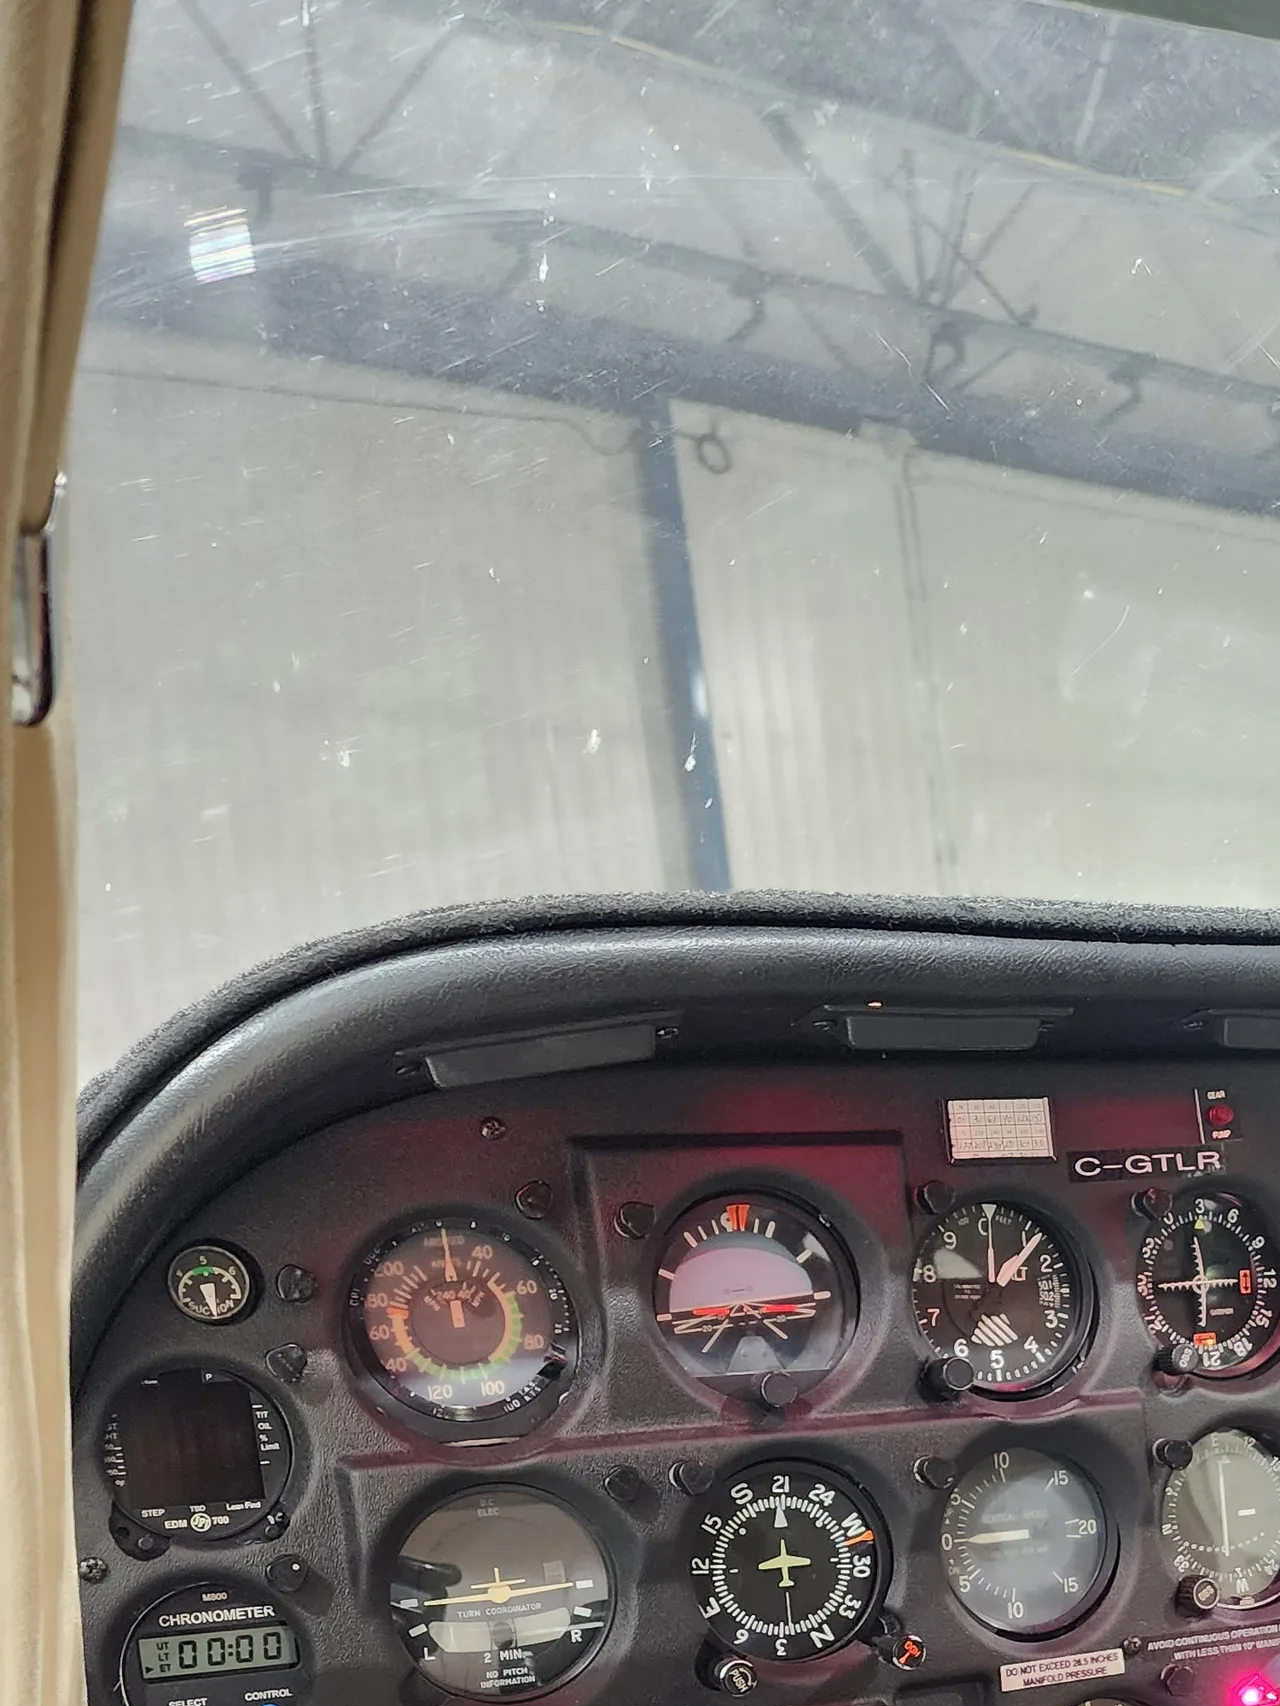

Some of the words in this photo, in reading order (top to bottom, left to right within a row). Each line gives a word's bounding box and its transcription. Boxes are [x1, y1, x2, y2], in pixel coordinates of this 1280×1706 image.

[1074, 1150, 1222, 1177] C-GTLR
[1195, 1198, 1205, 1214] 3
[1226, 1208, 1239, 1223] 6
[943, 1231, 957, 1249] 9
[1251, 1236, 1265, 1250] 9
[200, 1255, 208, 1266] 5
[471, 1244, 494, 1260] 40
[1040, 1254, 1053, 1273] 2
[923, 1264, 937, 1283] 8
[1262, 1270, 1278, 1288] 12
[516, 1279, 537, 1295] 60
[189, 1299, 236, 1317] SUCION
[926, 1308, 940, 1327] 7
[1044, 1309, 1058, 1328] 3
[1255, 1308, 1274, 1329] 15
[523, 1334, 545, 1350] 80
[953, 1338, 968, 1357] 6
[1023, 1335, 1040, 1353] 4
[990, 1350, 1005, 1369] 5
[427, 1384, 454, 1400] 120
[480, 1380, 505, 1397] 100
[993, 1451, 1010, 1470] 10
[771, 1475, 790, 1493] 21
[1054, 1470, 1069, 1486] 15
[730, 1482, 754, 1505] S
[808, 1482, 837, 1507] 24
[211, 1515, 230, 1526] 700
[700, 1513, 723, 1535] 15
[1078, 1519, 1097, 1535] 20
[942, 1533, 953, 1551] 0
[691, 1557, 710, 1576] 12
[853, 1554, 872, 1578] 30
[958, 1575, 970, 1593] 5
[1063, 1577, 1079, 1593] 15
[457, 1610, 482, 1619] TURN
[485, 1602, 542, 1616] COORDINATOR
[699, 1596, 721, 1620] E
[838, 1594, 862, 1620] 33
[1007, 1602, 1024, 1619] 10
[158, 1605, 276, 1628] CHRONOMETER
[570, 1630, 583, 1643] R
[809, 1623, 835, 1649] N
[1147, 1638, 1175, 1651] AVOID
[1176, 1632, 1230, 1647] CONTINUOUS
[1230, 1624, 1278, 1642] OPERATION
[156, 1641, 170, 1651] UT
[178, 1631, 282, 1670] 00:00
[423, 1647, 436, 1661] L
[775, 1638, 787, 1656] 3
[1174, 1649, 1197, 1662] WITH
[1197, 1646, 1219, 1659] LESS
[158, 1652, 170, 1662] LT
[484, 1652, 493, 1664] 2
[1005, 1668, 1018, 1678] DO
[1019, 1663, 1037, 1676] NOT
[1038, 1659, 1072, 1674] EXCEED
[1090, 1652, 1119, 1665] INCHES
[159, 1663, 172, 1673] ET
[503, 1667, 529, 1676] PITCH
[1023, 1674, 1065, 1688] MANIFOLD
[1066, 1666, 1108, 1680] PRESSURE
[480, 1675, 536, 1689] INFORMATION
[244, 1688, 293, 1701] CONTROL
